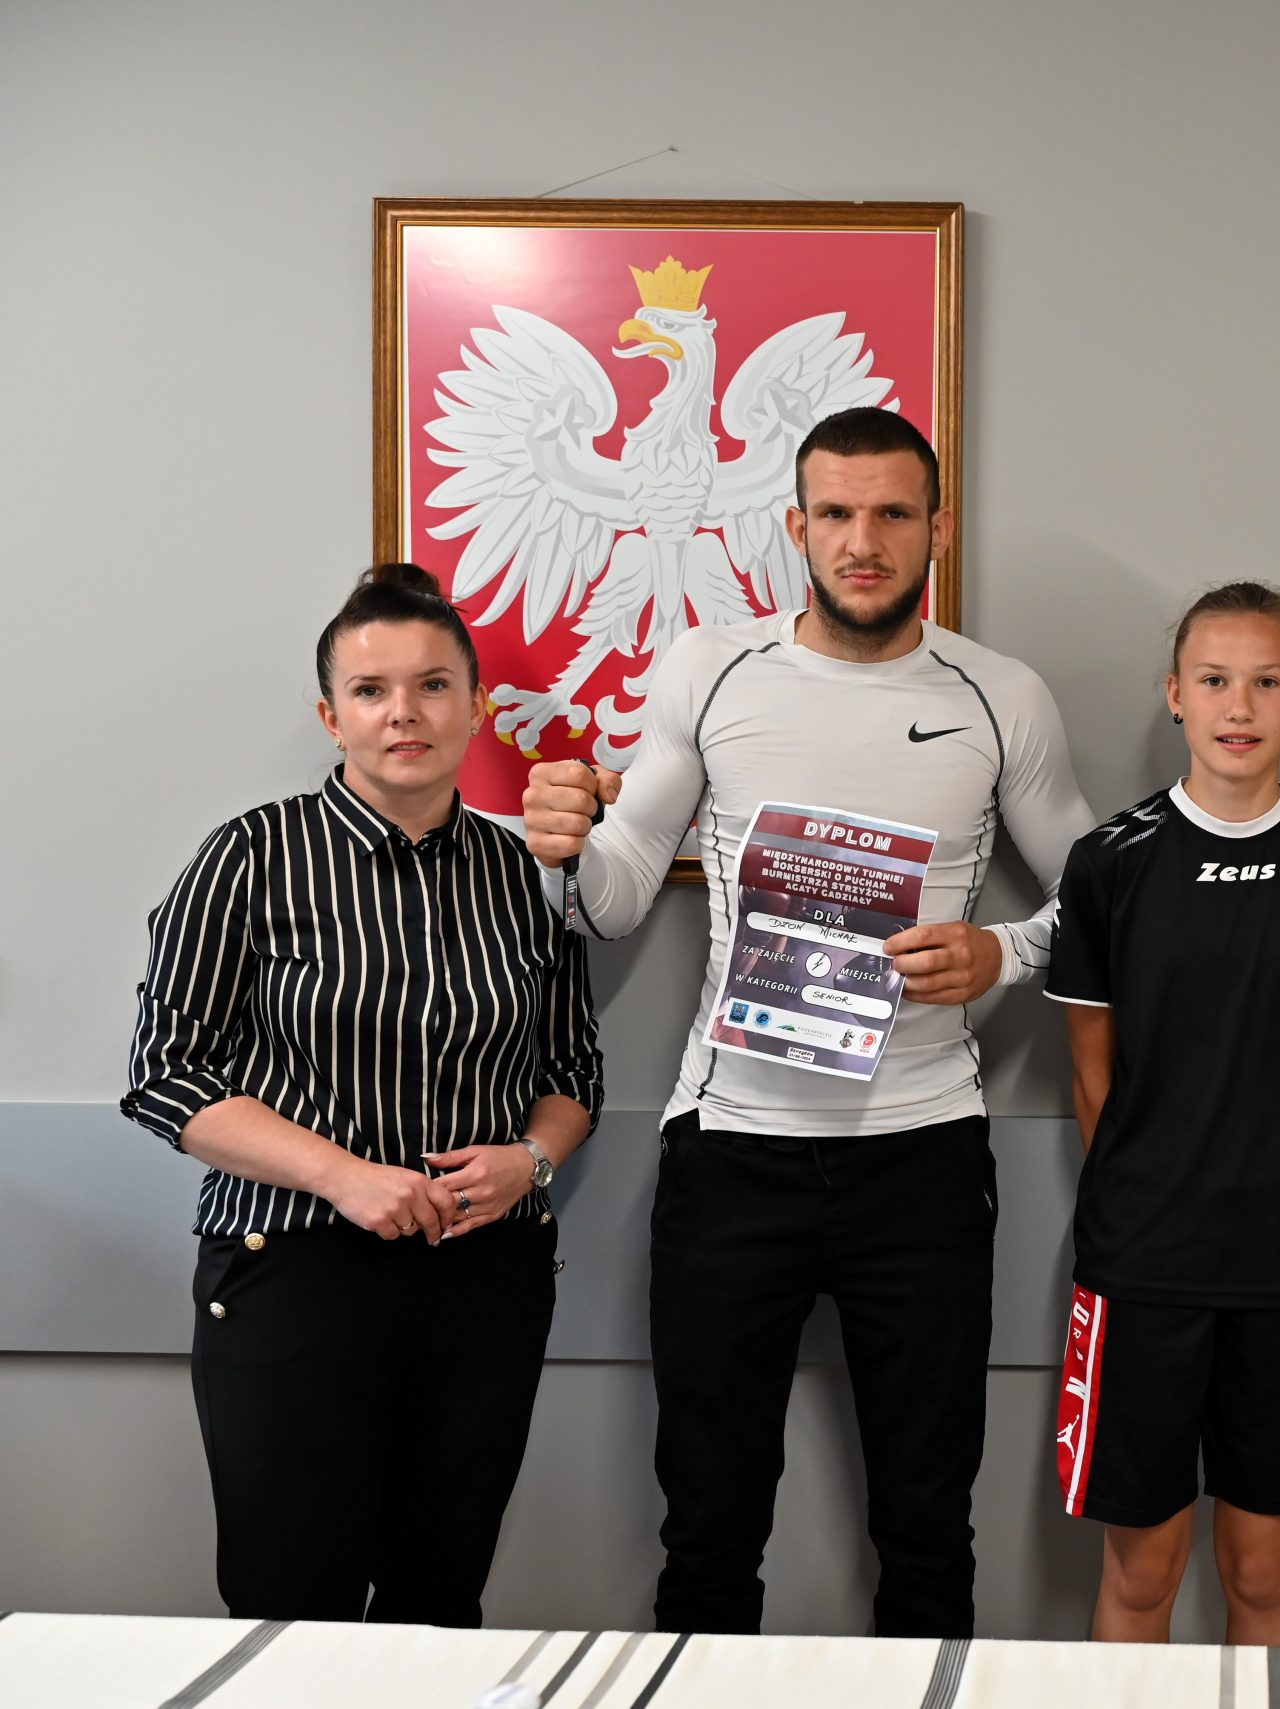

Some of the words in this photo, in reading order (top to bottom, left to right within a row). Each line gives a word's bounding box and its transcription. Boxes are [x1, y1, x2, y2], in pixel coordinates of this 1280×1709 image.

[803, 822, 892, 851] DYPLOM
[762, 849, 859, 876] MIĘDZYNARODOWY
[862, 869, 904, 885] TURNIEJ
[773, 860, 831, 880] BOKSERSKI
[835, 873, 841, 881] O
[845, 874, 886, 890] PUCHAR
[1196, 863, 1275, 882] Zeus
[762, 868, 828, 888] BURMISTRZA
[832, 881, 894, 901] STRZYŻOWA
[785, 882, 817, 894] AGATY
[822, 890, 872, 905] GADZIAŁY
[813, 910, 845, 926] DLA
[742, 946, 754, 954] ZA
[757, 949, 796, 964] ZAJĘCIE
[735, 974, 744, 982] W
[747, 976, 797, 994] KATEGORII
[840, 967, 882, 983] MIEJSCA
[813, 991, 852, 1005] SENIOR
